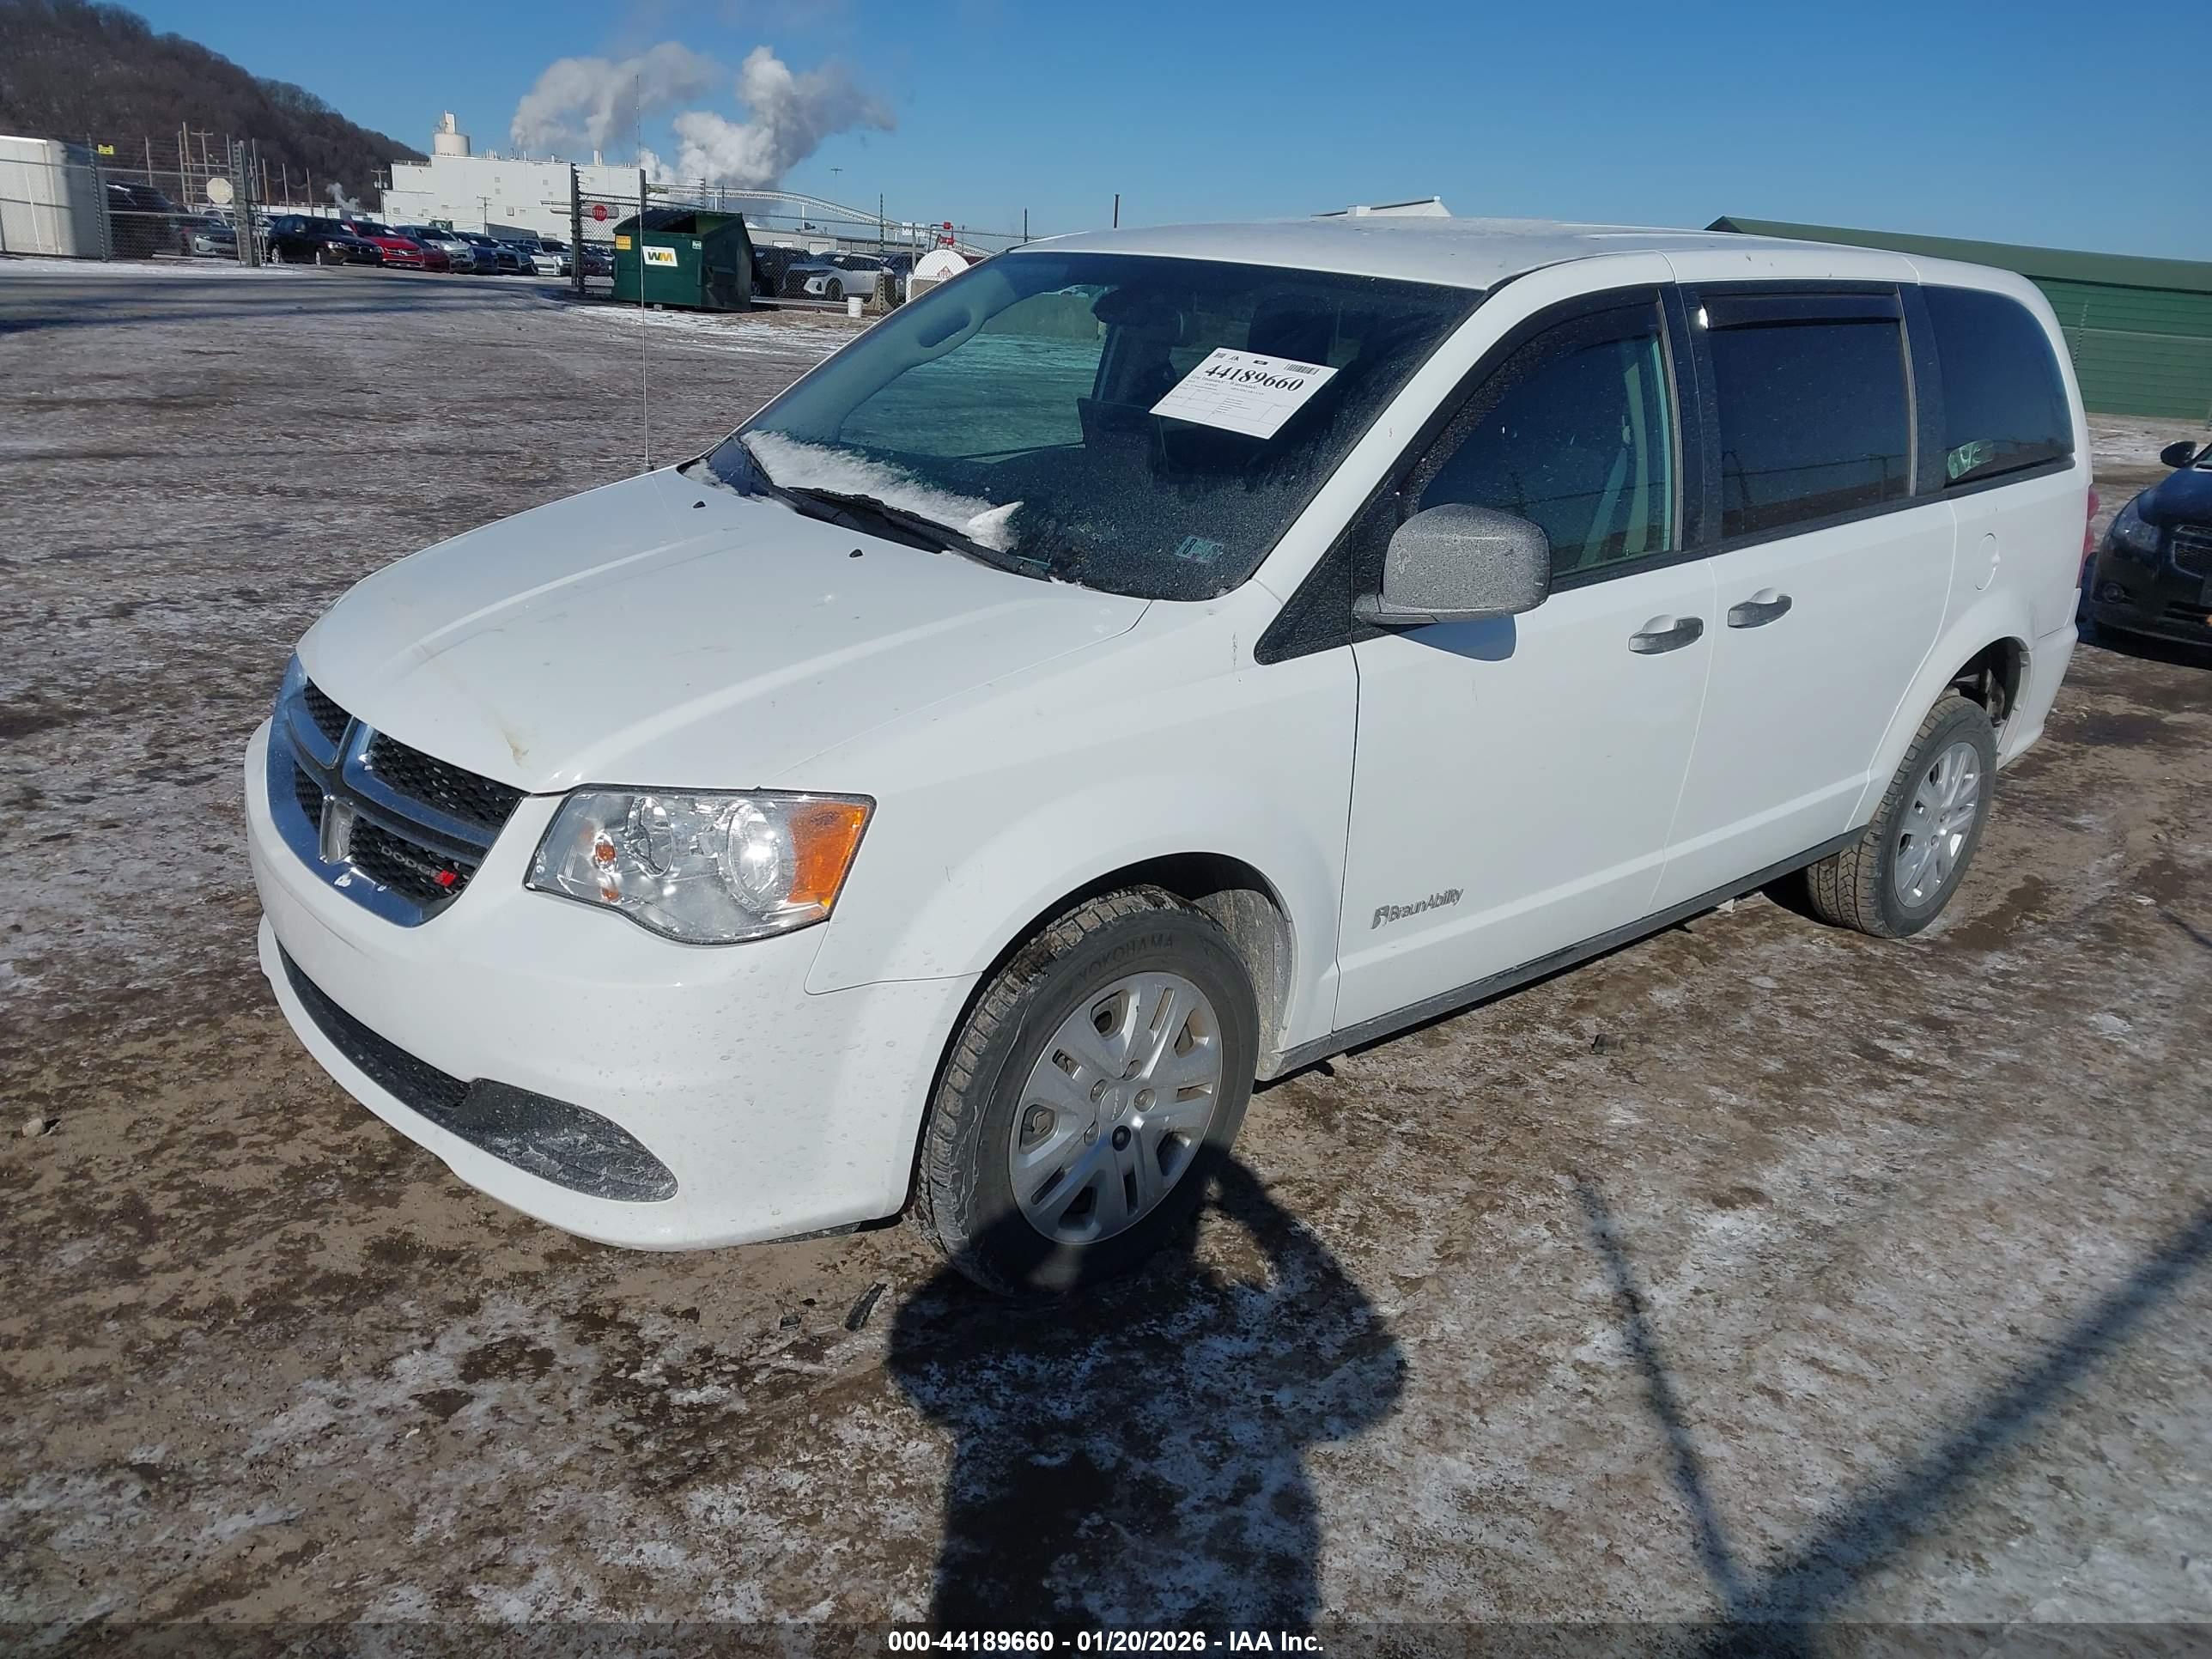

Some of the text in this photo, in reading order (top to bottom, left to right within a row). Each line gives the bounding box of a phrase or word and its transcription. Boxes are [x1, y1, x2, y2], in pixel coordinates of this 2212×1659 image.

[592, 210, 607, 218] STOP
[647, 251, 673, 262] WM
[1205, 364, 1304, 392] 44189660
[380, 844, 440, 879] DODGE
[1388, 888, 1464, 922] BraunAbility
[1078, 933, 1174, 977] YOKOHAMA
